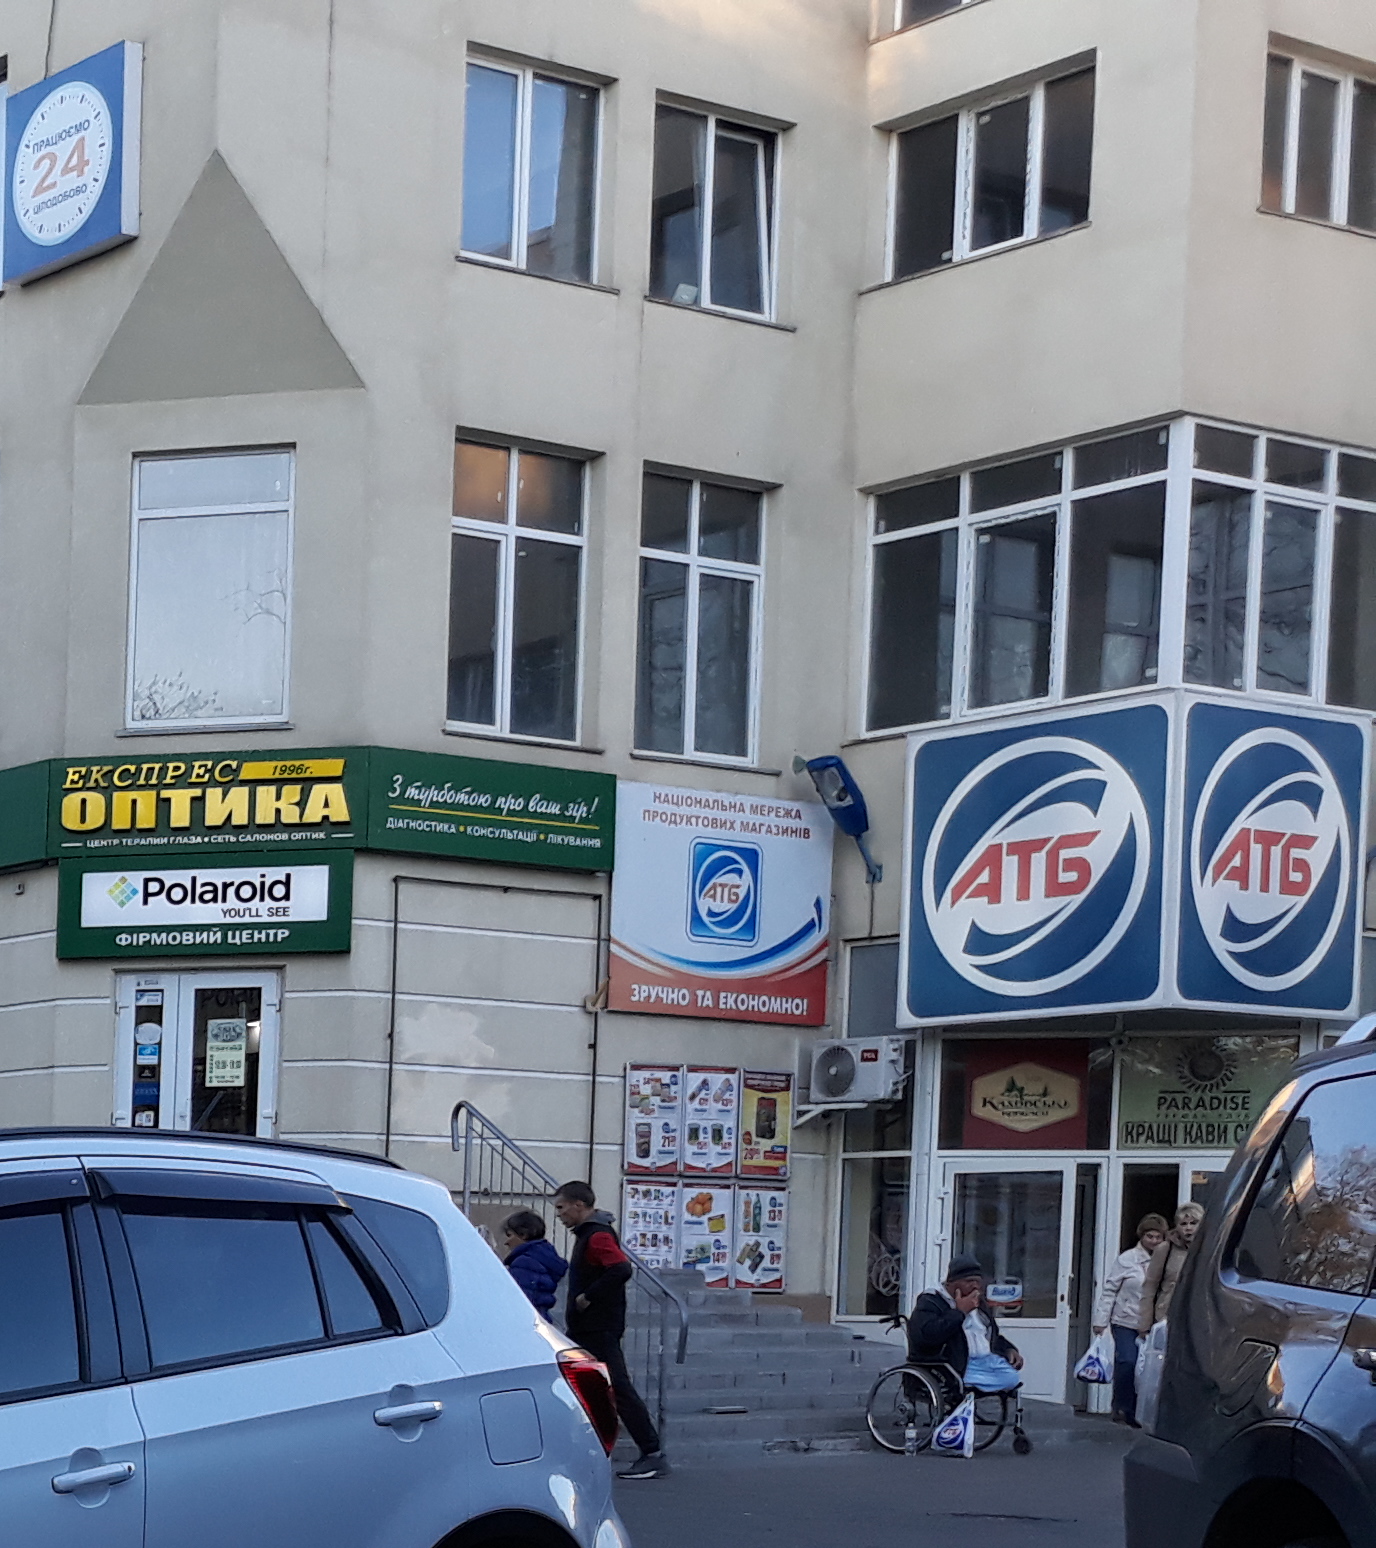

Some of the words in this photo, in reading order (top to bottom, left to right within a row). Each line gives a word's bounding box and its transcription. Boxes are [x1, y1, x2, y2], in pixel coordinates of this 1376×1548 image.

[32, 119, 90, 154] ПРАЦЮЄМО
[32, 136, 89, 198] 24
[33, 184, 87, 215] ЦІЛОДОБОВО
[62, 760, 239, 789] ЕКСПРЕС
[61, 784, 350, 831] ОПТИКА
[405, 781, 491, 808] турботою
[495, 794, 523, 815] про
[528, 794, 561, 815] ваш
[564, 797, 598, 823] зір!
[653, 792, 746, 814] НАЦІОНАЛЬНА
[750, 804, 802, 821] МЕРЕЖА
[86, 838, 120, 848] ЦЕНТР
[169, 835, 202, 845] ГЛАЗА
[211, 834, 236, 844] СЕТЬ
[239, 833, 289, 842] САЛОНОВ
[291, 831, 326, 841] ОПТИК
[386, 817, 456, 834] ДІАГНОСТИКА
[466, 824, 537, 842] КОНСУЛЬТАЦІЇ
[547, 833, 601, 848] ЛІКУВАННЯ
[642, 809, 736, 831] ПРОДУКТОВИХ
[739, 821, 811, 839] МАГАЗИНІВ
[950, 828, 1103, 910] АТБ
[1211, 827, 1319, 897] АТБ
[142, 873, 291, 906] Polaroid
[703, 881, 742, 904] АТБ
[267, 907, 290, 918] SEE
[115, 928, 221, 946] ФІРМОВИЙ
[227, 929, 290, 946] ЦЕНТР
[630, 984, 690, 1006] ЗРУЧНО
[696, 990, 713, 1008] ТА
[719, 992, 808, 1015] ЕКОНОМНО!
[1157, 1095, 1251, 1111] PARADISE
[1124, 1122, 1177, 1146] КРАЩІ
[1183, 1122, 1228, 1145] КАВИ
